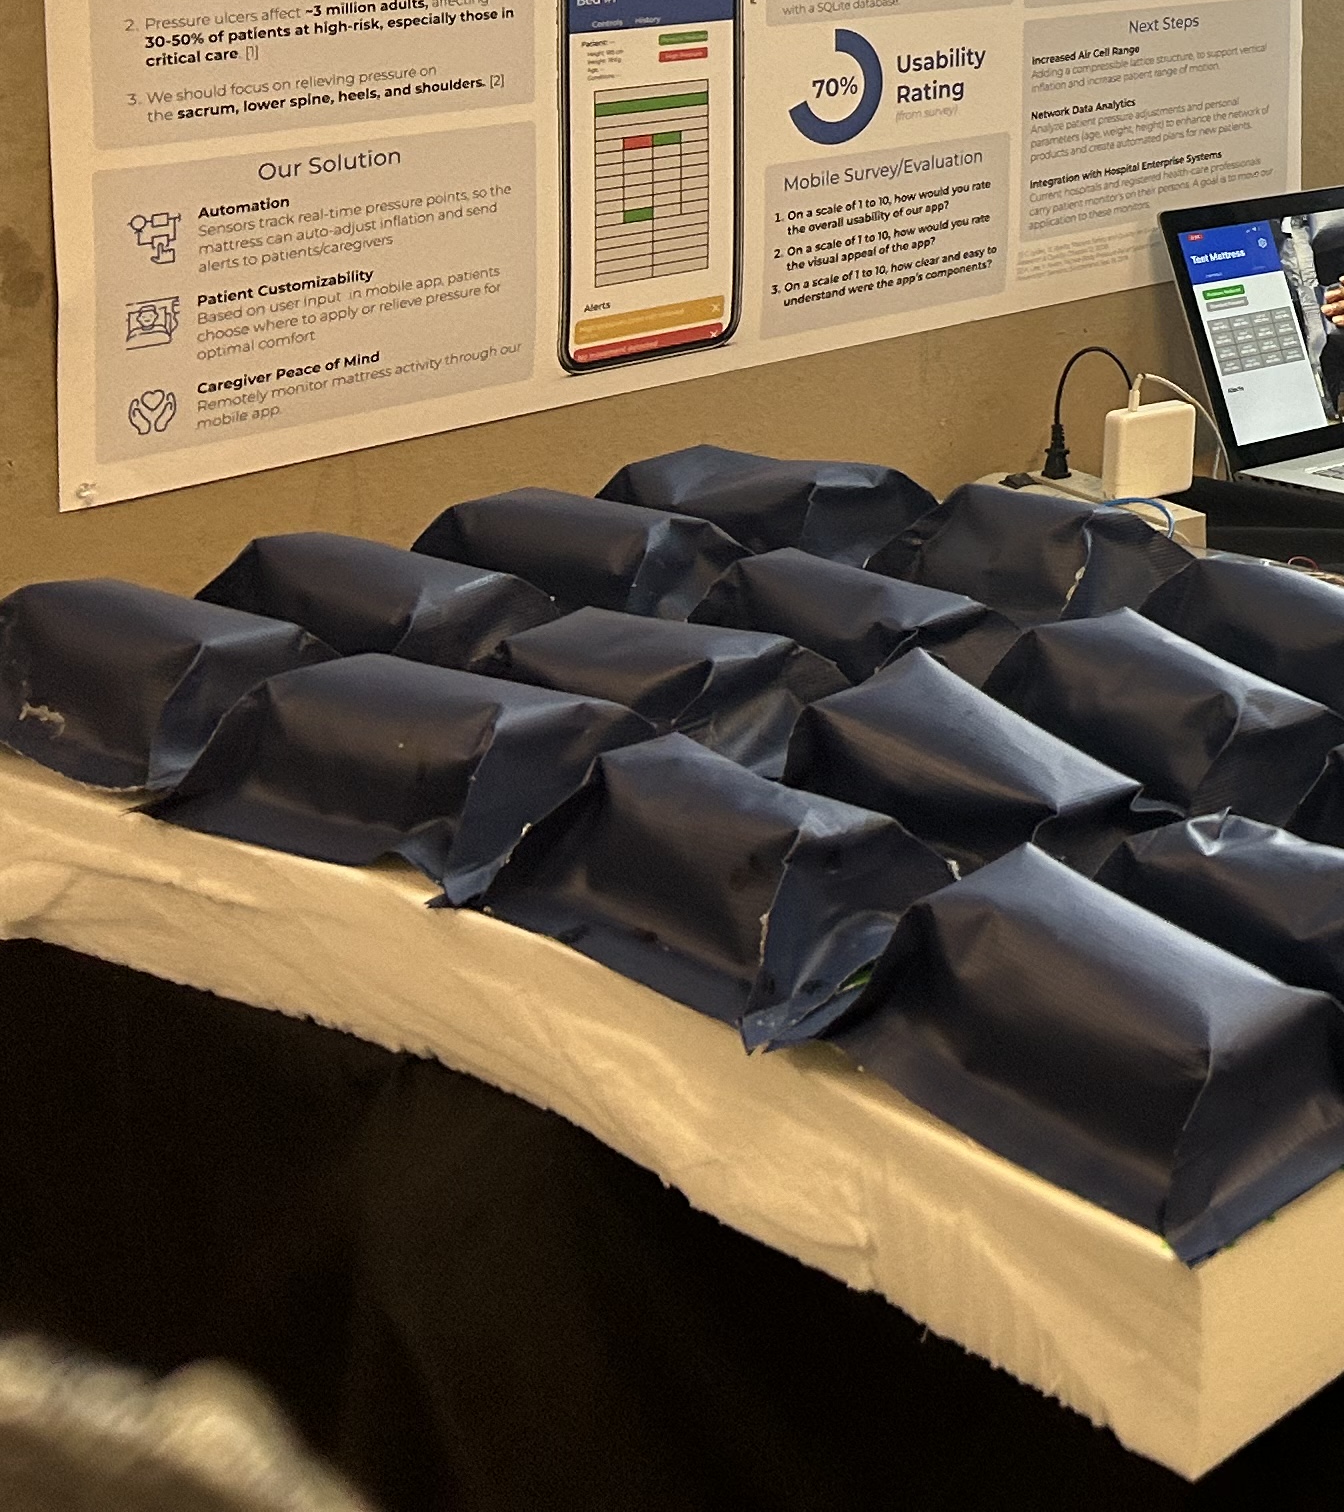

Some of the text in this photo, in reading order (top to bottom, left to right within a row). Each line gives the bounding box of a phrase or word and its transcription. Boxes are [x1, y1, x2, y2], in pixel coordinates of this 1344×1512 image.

[145, 7, 514, 49] 30-50% of patients at high-risk, especially those in
[592, 16, 661, 28] Controls History
[1129, 17, 1200, 34] Next Steps
[896, 46, 986, 74] Usability
[1032, 47, 1140, 65] Increased Air Cell Range
[812, 78, 858, 99] 70%
[897, 81, 965, 104] Rating
[1031, 99, 1136, 120] Network Data Analytics
[259, 151, 402, 181] Our Solution
[783, 150, 983, 192] Mobile Survey/Evaluation
[1029, 152, 1222, 188] Integration with Hospital Enterprise Systems
[198, 198, 290, 218] Automation
[786, 208, 804, 221] On
[805, 208, 813, 218] a
[814, 202, 843, 216] scale
[844, 199, 856, 212] of
[858, 198, 863, 210] 1
[864, 197, 876, 209] to
[878, 194, 892, 207] 10,
[893, 192, 916, 204] how
[917, 184, 950, 200] would
[950, 184, 970, 198] you
[971, 179, 991, 192] rate
[197, 270, 374, 306] Patient Customizability
[584, 302, 611, 312] Alerts
[197, 350, 380, 394] Caregiver Peace of Mind
